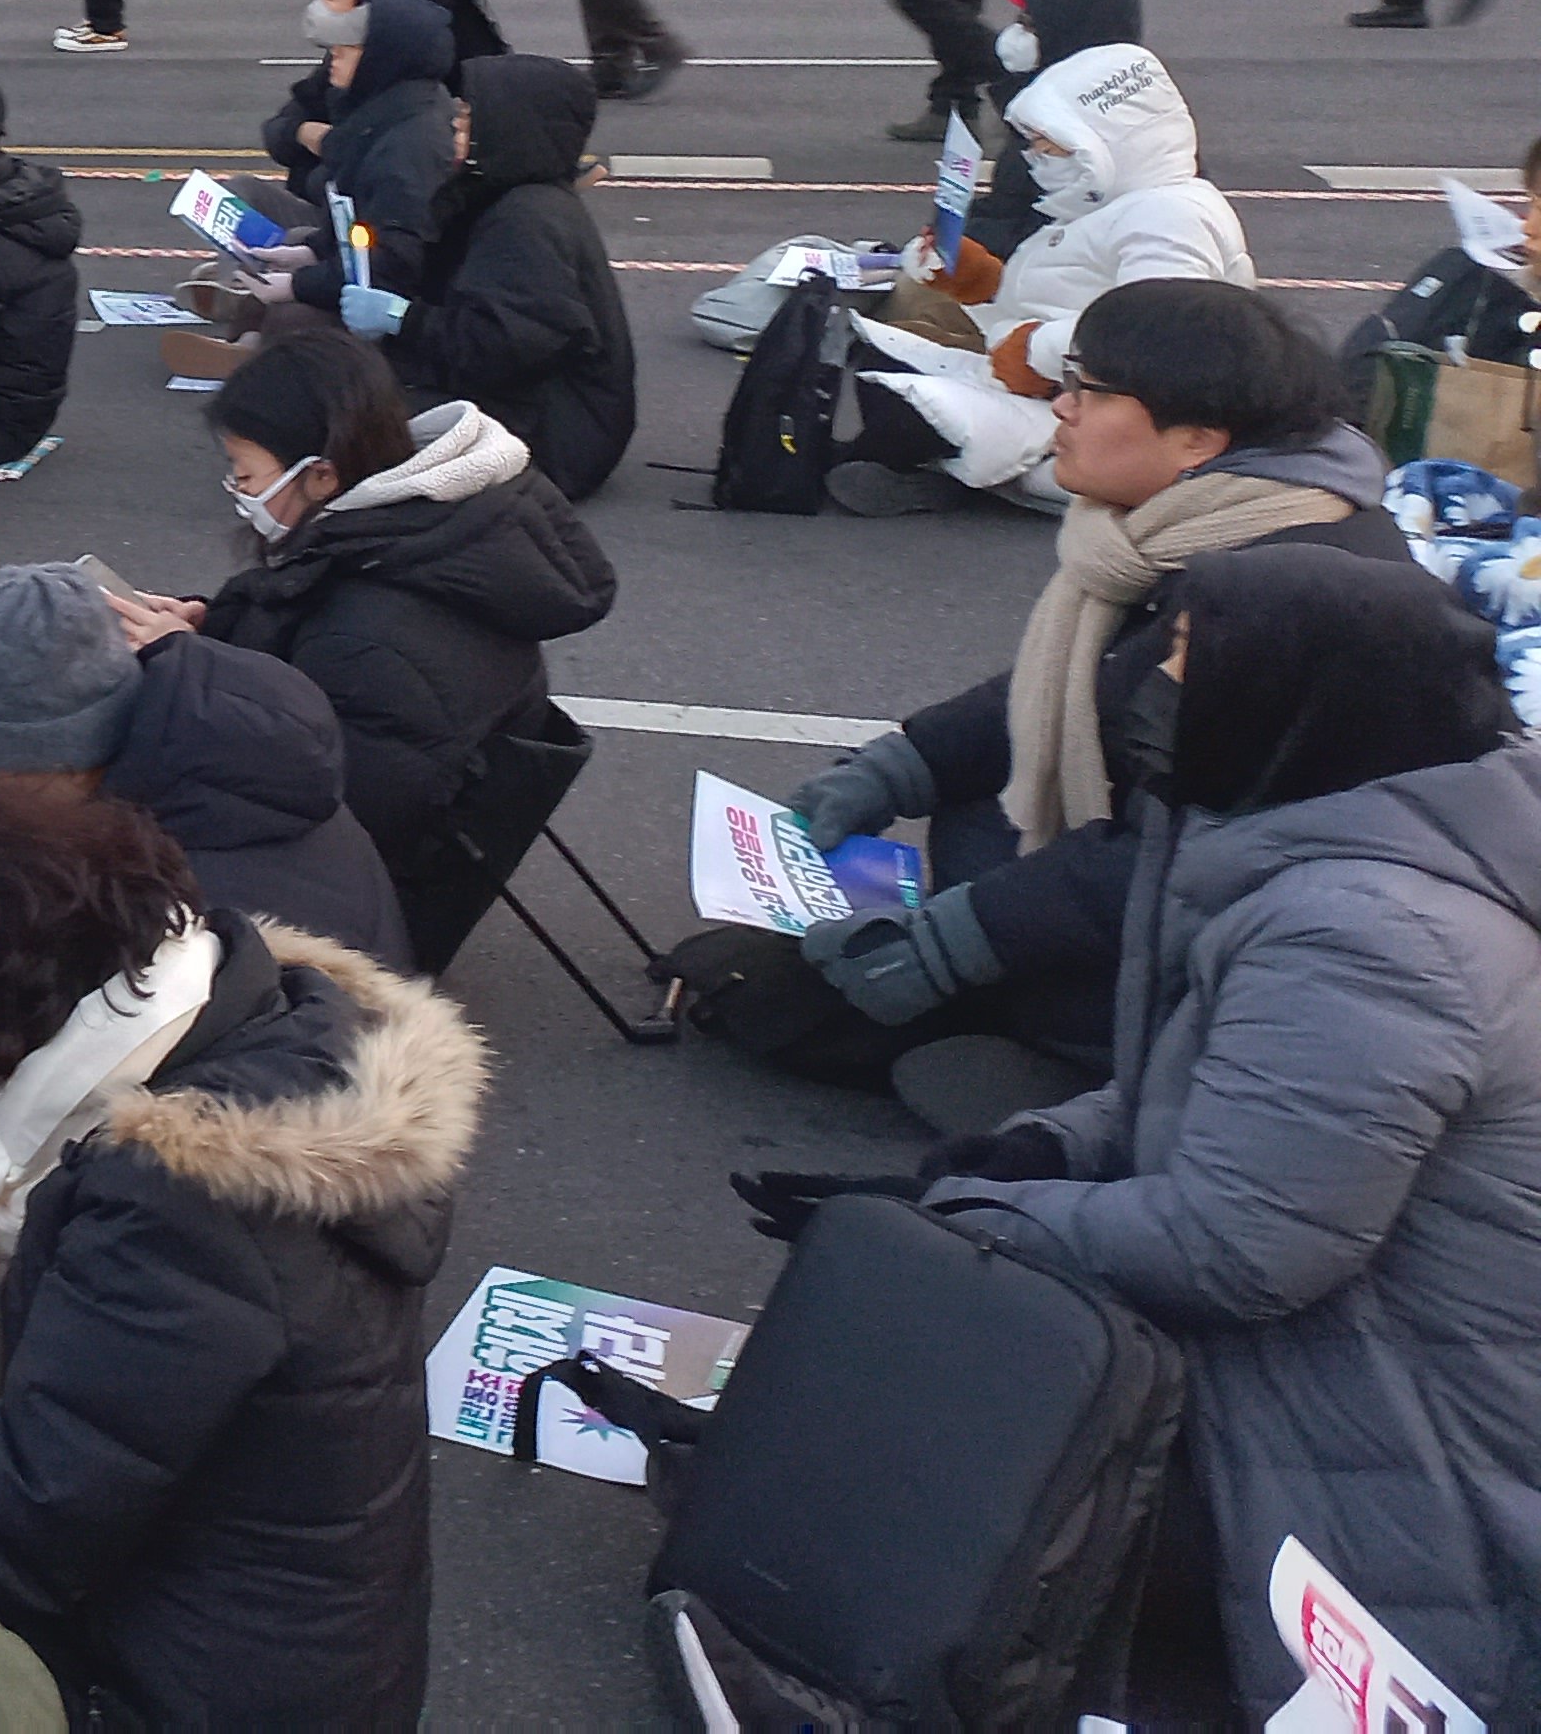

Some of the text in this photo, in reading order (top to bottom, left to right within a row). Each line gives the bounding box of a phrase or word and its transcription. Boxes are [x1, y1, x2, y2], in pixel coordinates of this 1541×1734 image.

[1076, 59, 1149, 107] Thankful for
[1097, 74, 1154, 115] friendship
[725, 805, 778, 889] 윤석열은
[473, 1286, 577, 1373] 해체
[454, 1367, 503, 1443] 내란동조
